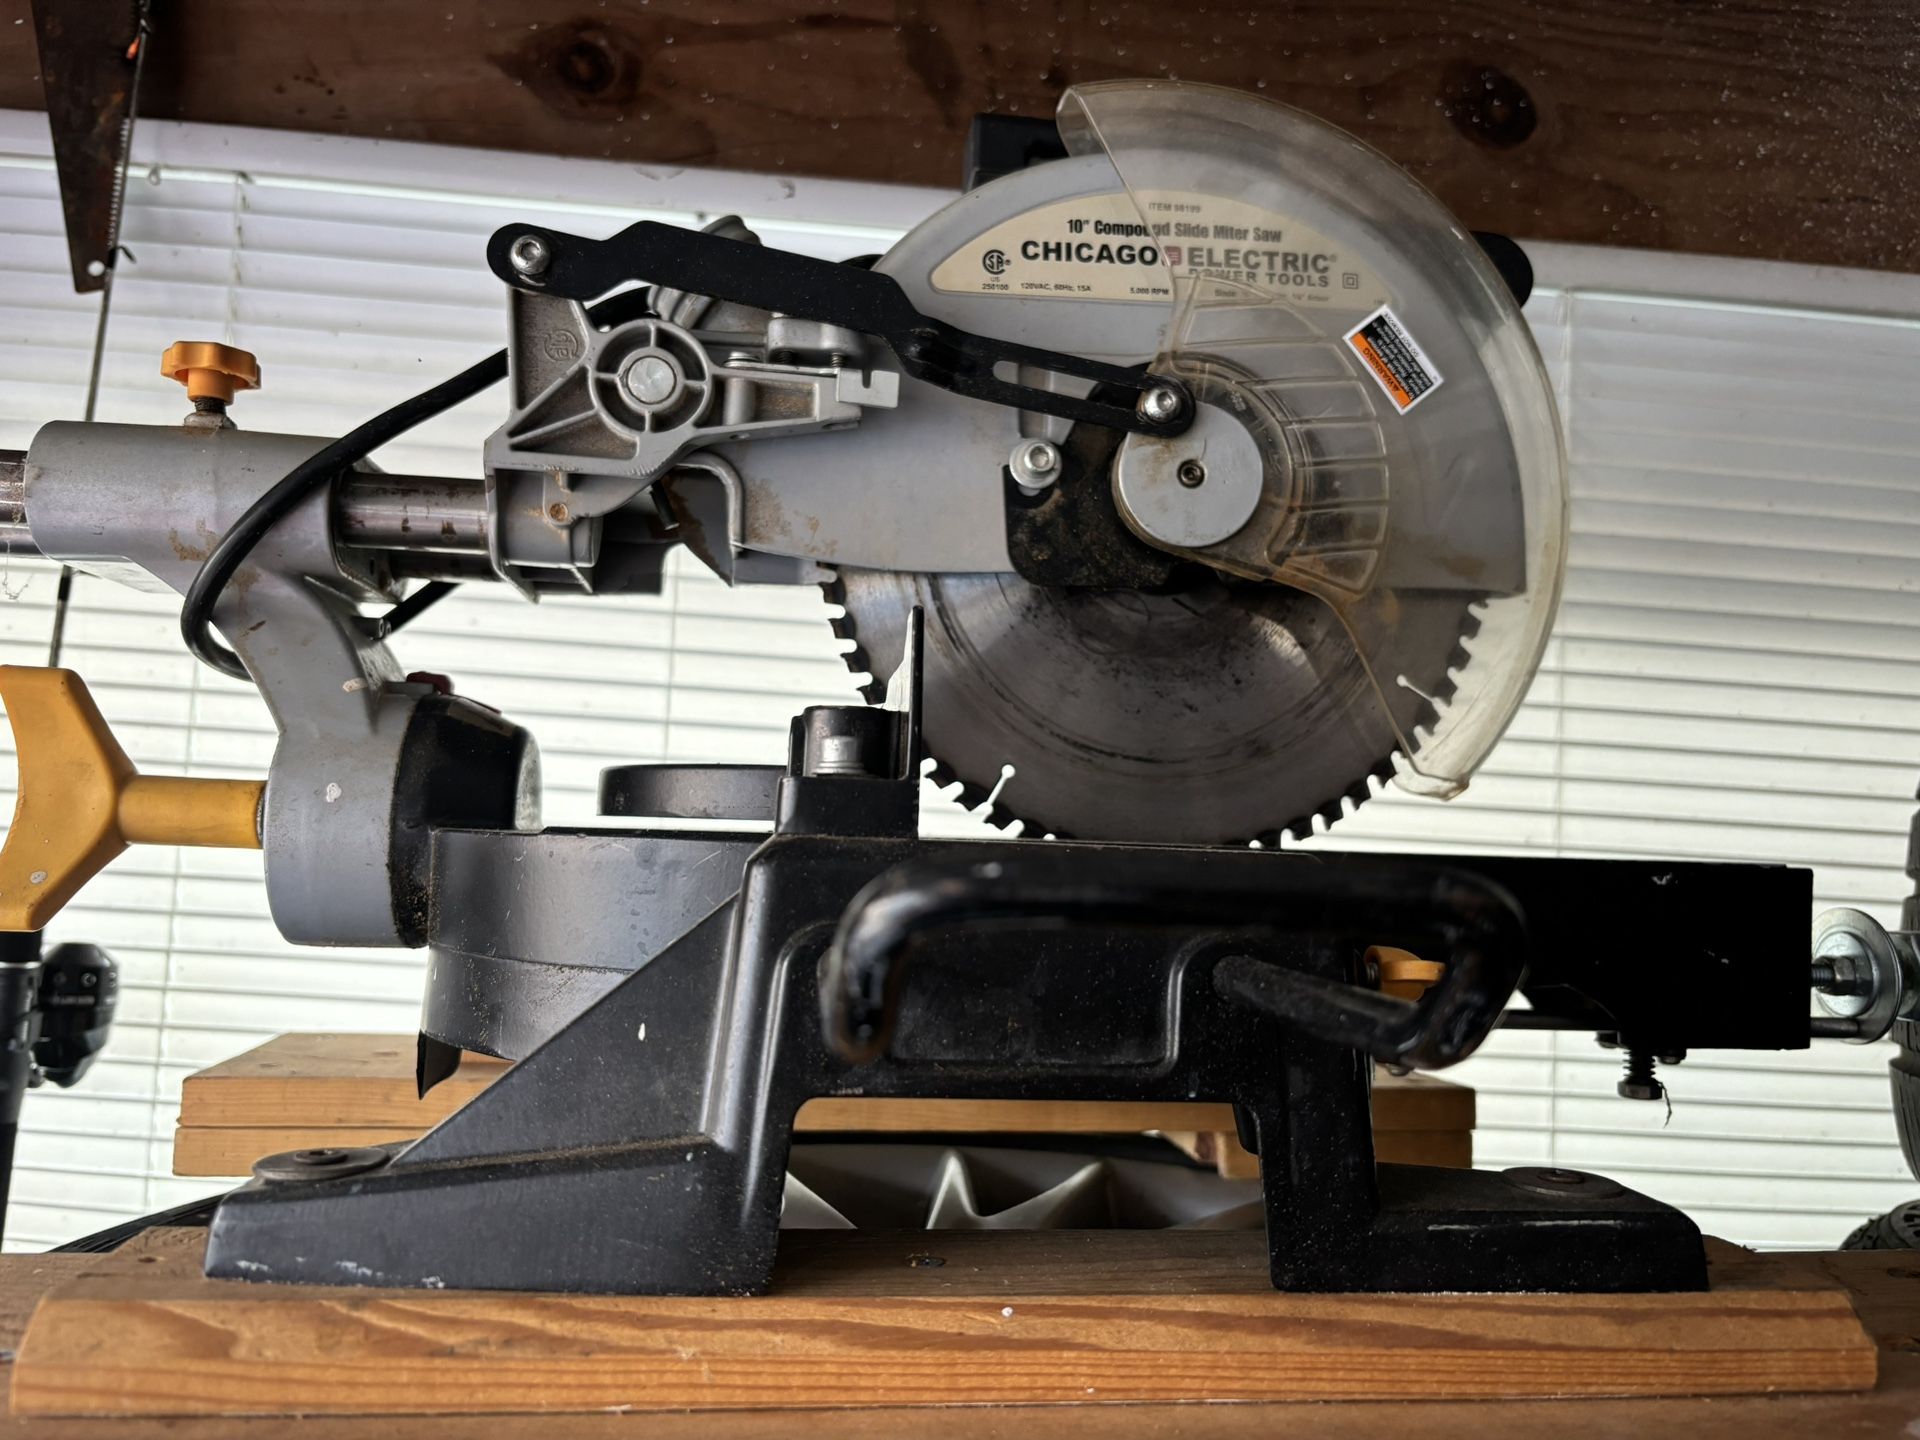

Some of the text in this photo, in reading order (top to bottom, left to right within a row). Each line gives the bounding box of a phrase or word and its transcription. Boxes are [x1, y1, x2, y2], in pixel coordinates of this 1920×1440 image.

[1149, 202, 1172, 212] ITEM
[1067, 219, 1090, 234] 10"
[1175, 222, 1209, 239] Slide
[1213, 224, 1249, 241] Miter
[1253, 227, 1282, 243] Saw
[1021, 240, 1158, 267] CHICAGO
[1266, 272, 1330, 288] TOOLS
[1362, 346, 1394, 386] WARNING
